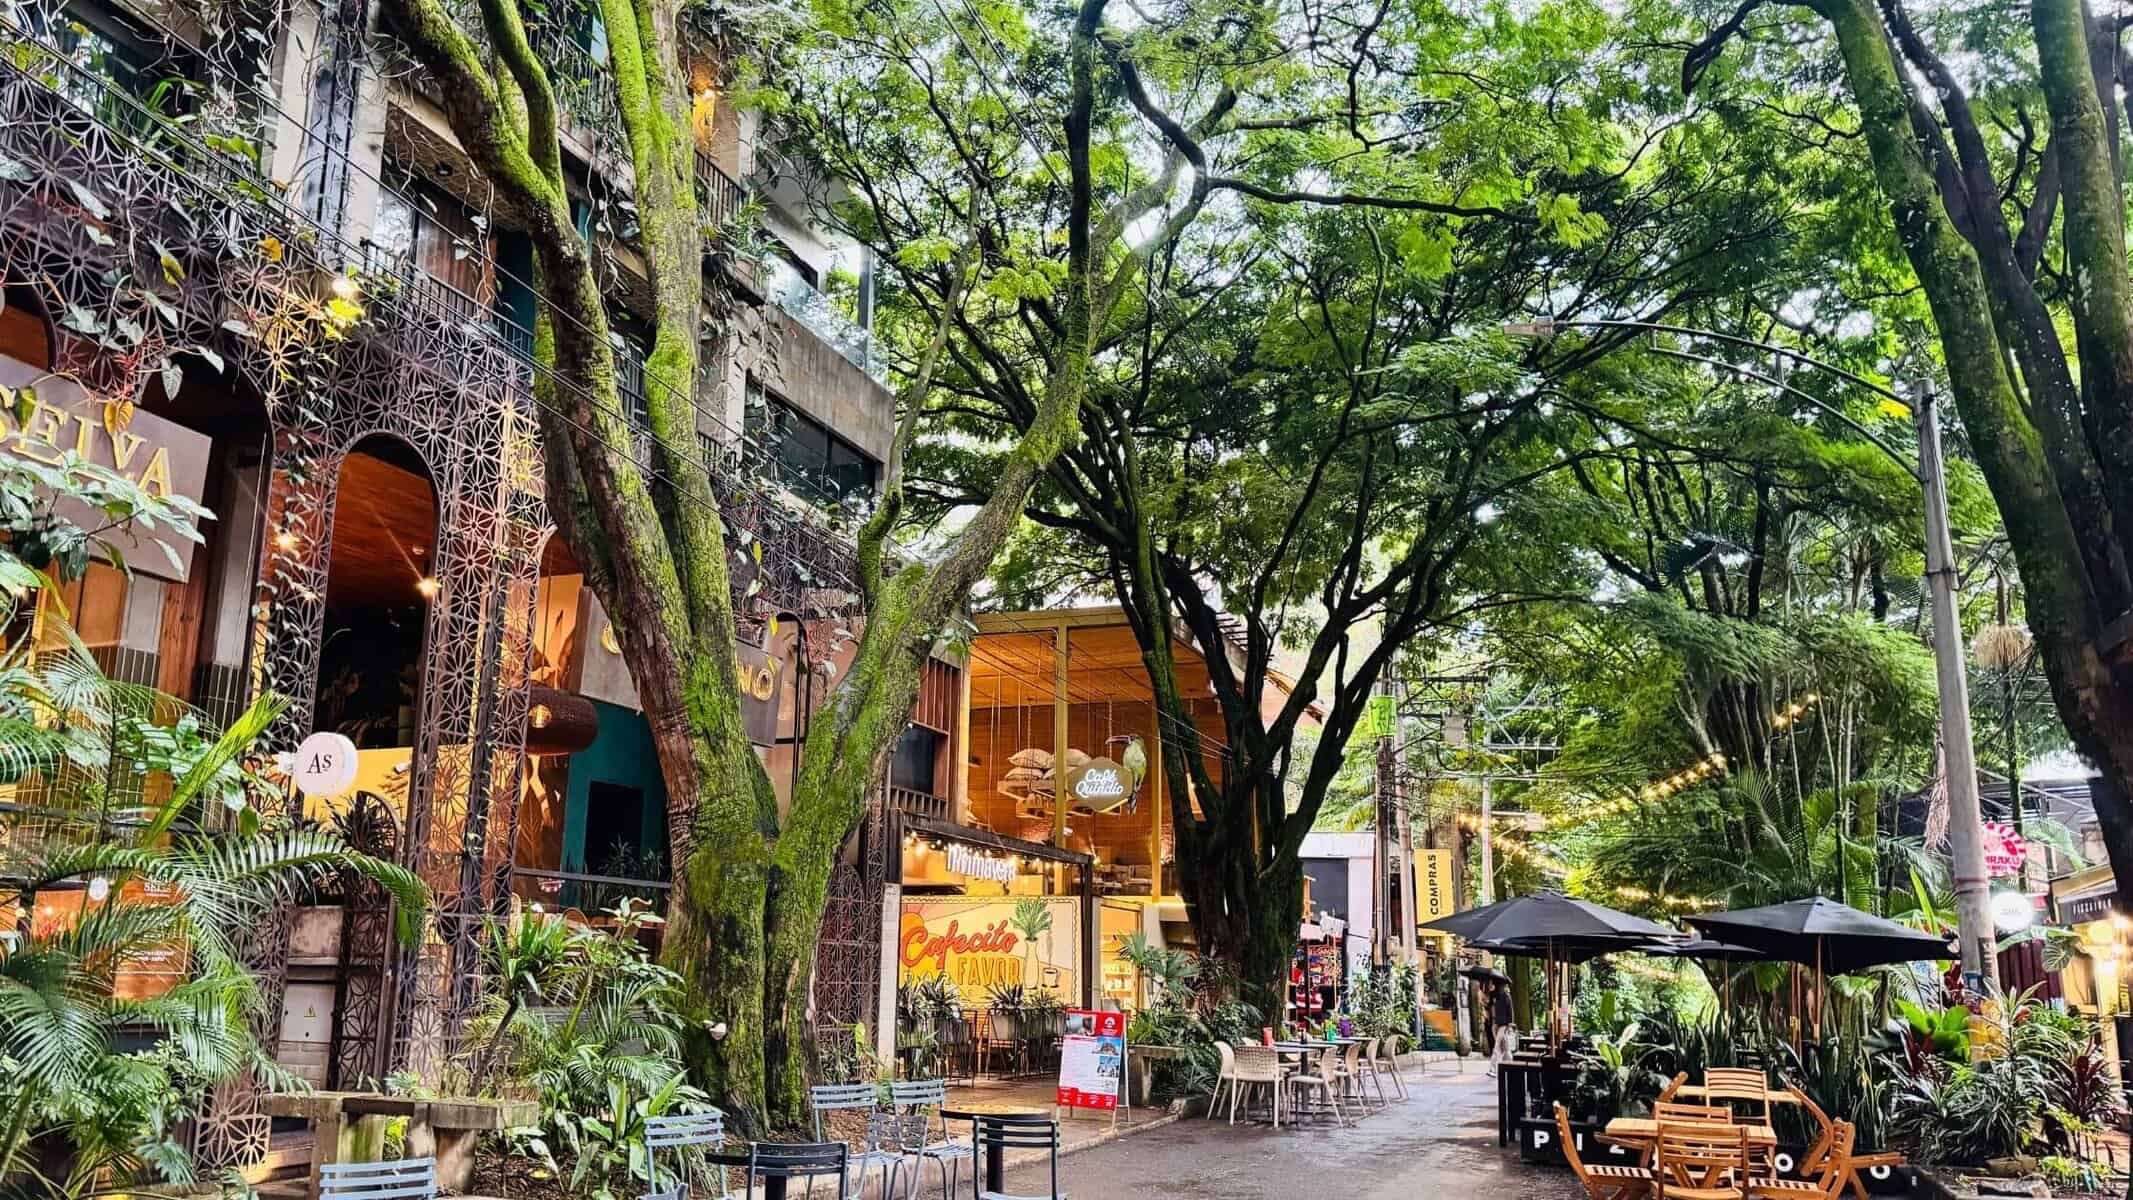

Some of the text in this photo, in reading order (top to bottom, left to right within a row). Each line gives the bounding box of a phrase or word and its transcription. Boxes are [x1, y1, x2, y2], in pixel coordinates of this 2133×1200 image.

[1085, 768, 1118, 784] Café
[1427, 854, 1439, 915] COMPRAS
[901, 919, 1018, 969] Cafecito
[957, 957, 1021, 986] FAVOR
